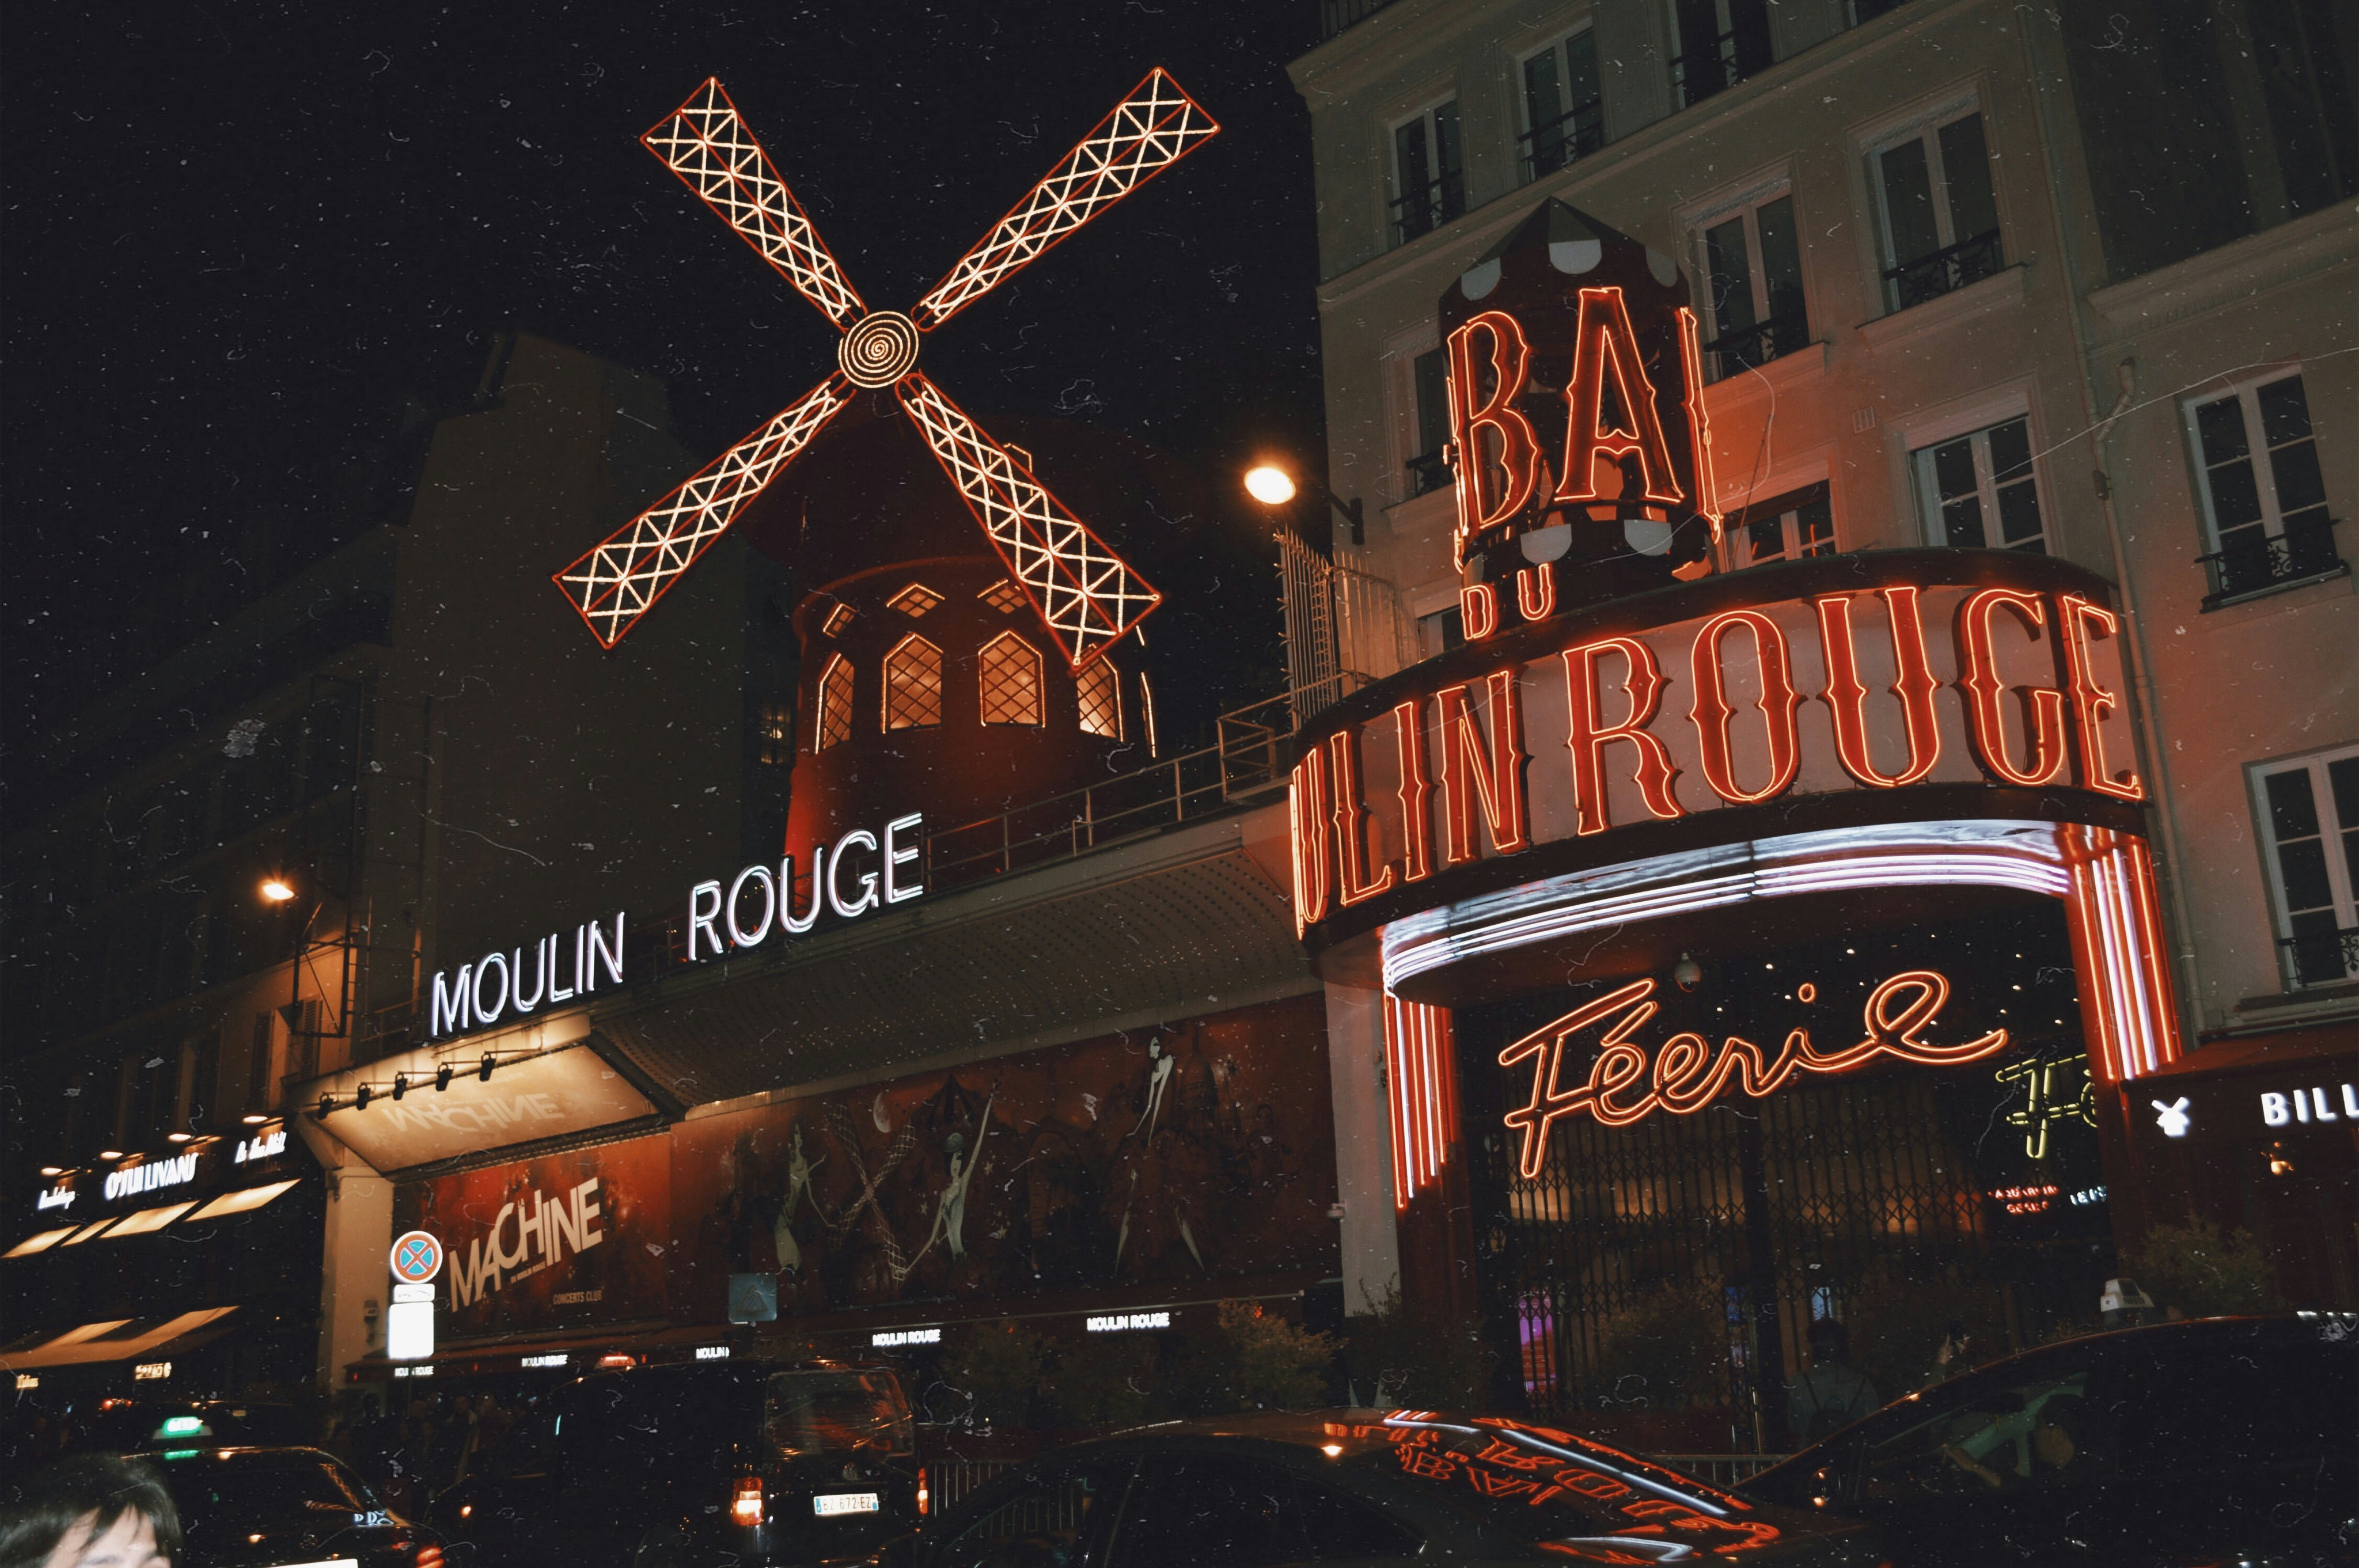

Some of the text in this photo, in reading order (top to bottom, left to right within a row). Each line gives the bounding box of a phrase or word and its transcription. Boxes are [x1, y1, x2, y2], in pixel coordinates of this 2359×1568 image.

[1459, 563, 1557, 641] DU
[1290, 585, 2142, 940] ULIN ROUGE
[432, 811, 924, 1037] MOULIN ROUGE
[1499, 971, 2007, 1179] Féerie
[449, 1177, 603, 1313] MACHINE
[696, 1347, 725, 1360] MOULIN
[872, 1329, 941, 1347] MOULIN ROUGE
[1087, 1312, 1170, 1331] MOULIN ROUGE
